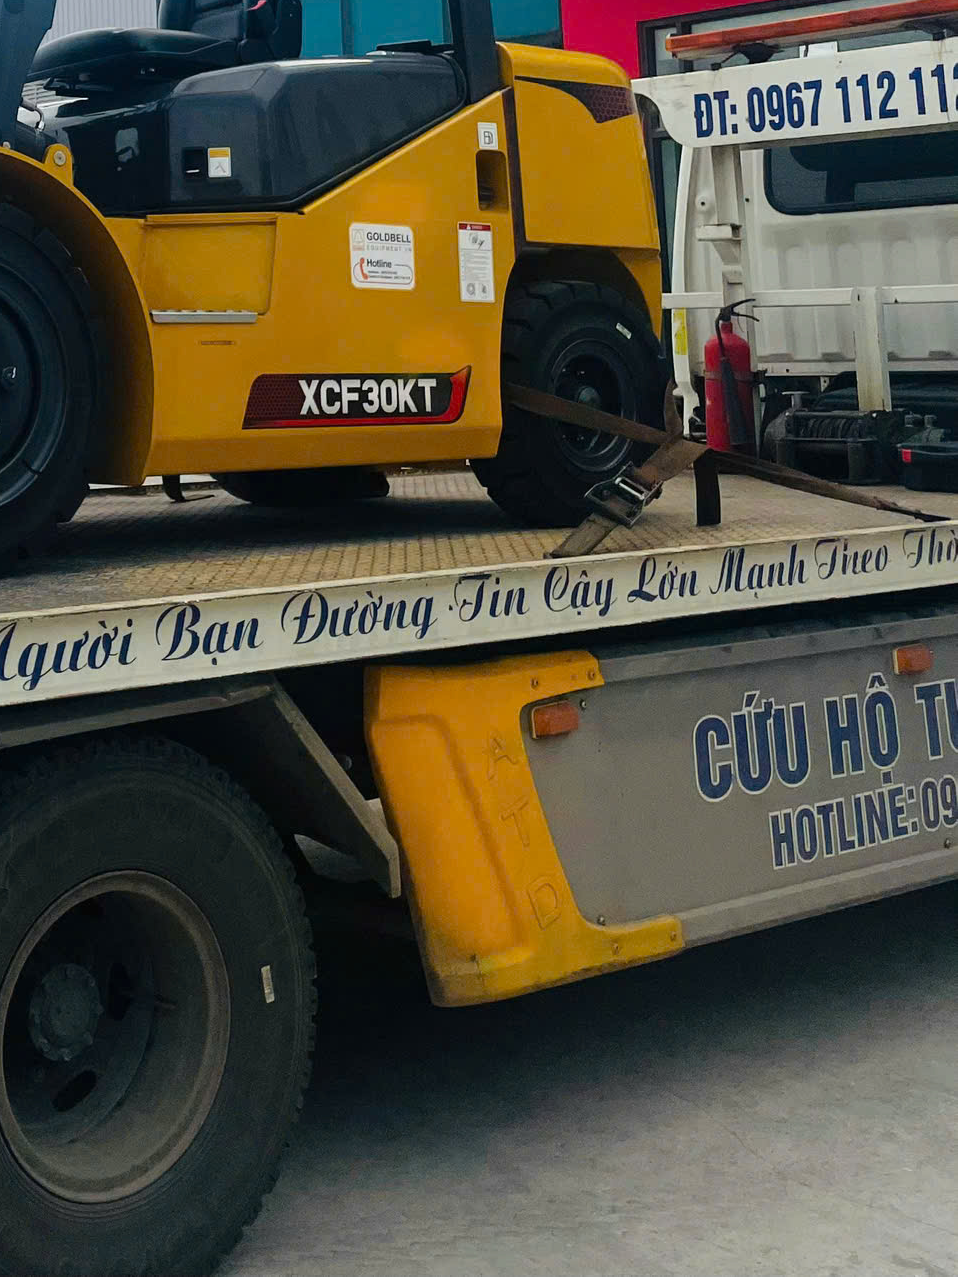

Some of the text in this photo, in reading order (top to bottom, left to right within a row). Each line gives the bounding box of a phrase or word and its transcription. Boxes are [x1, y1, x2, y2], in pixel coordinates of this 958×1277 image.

[694, 62, 958, 138] ĐT: 0967 112 11
[366, 231, 411, 243] GOLDBELL
[366, 258, 392, 269] Hotline
[299, 378, 437, 416] XCF30KT
[155, 603, 264, 666] Bạn
[281, 589, 438, 645] Đường
[454, 573, 530, 623] Tin
[543, 566, 616, 617] Cậy
[710, 542, 808, 598] Mạnh
[693, 691, 812, 802] CỨU
[823, 672, 901, 788] HỘ
